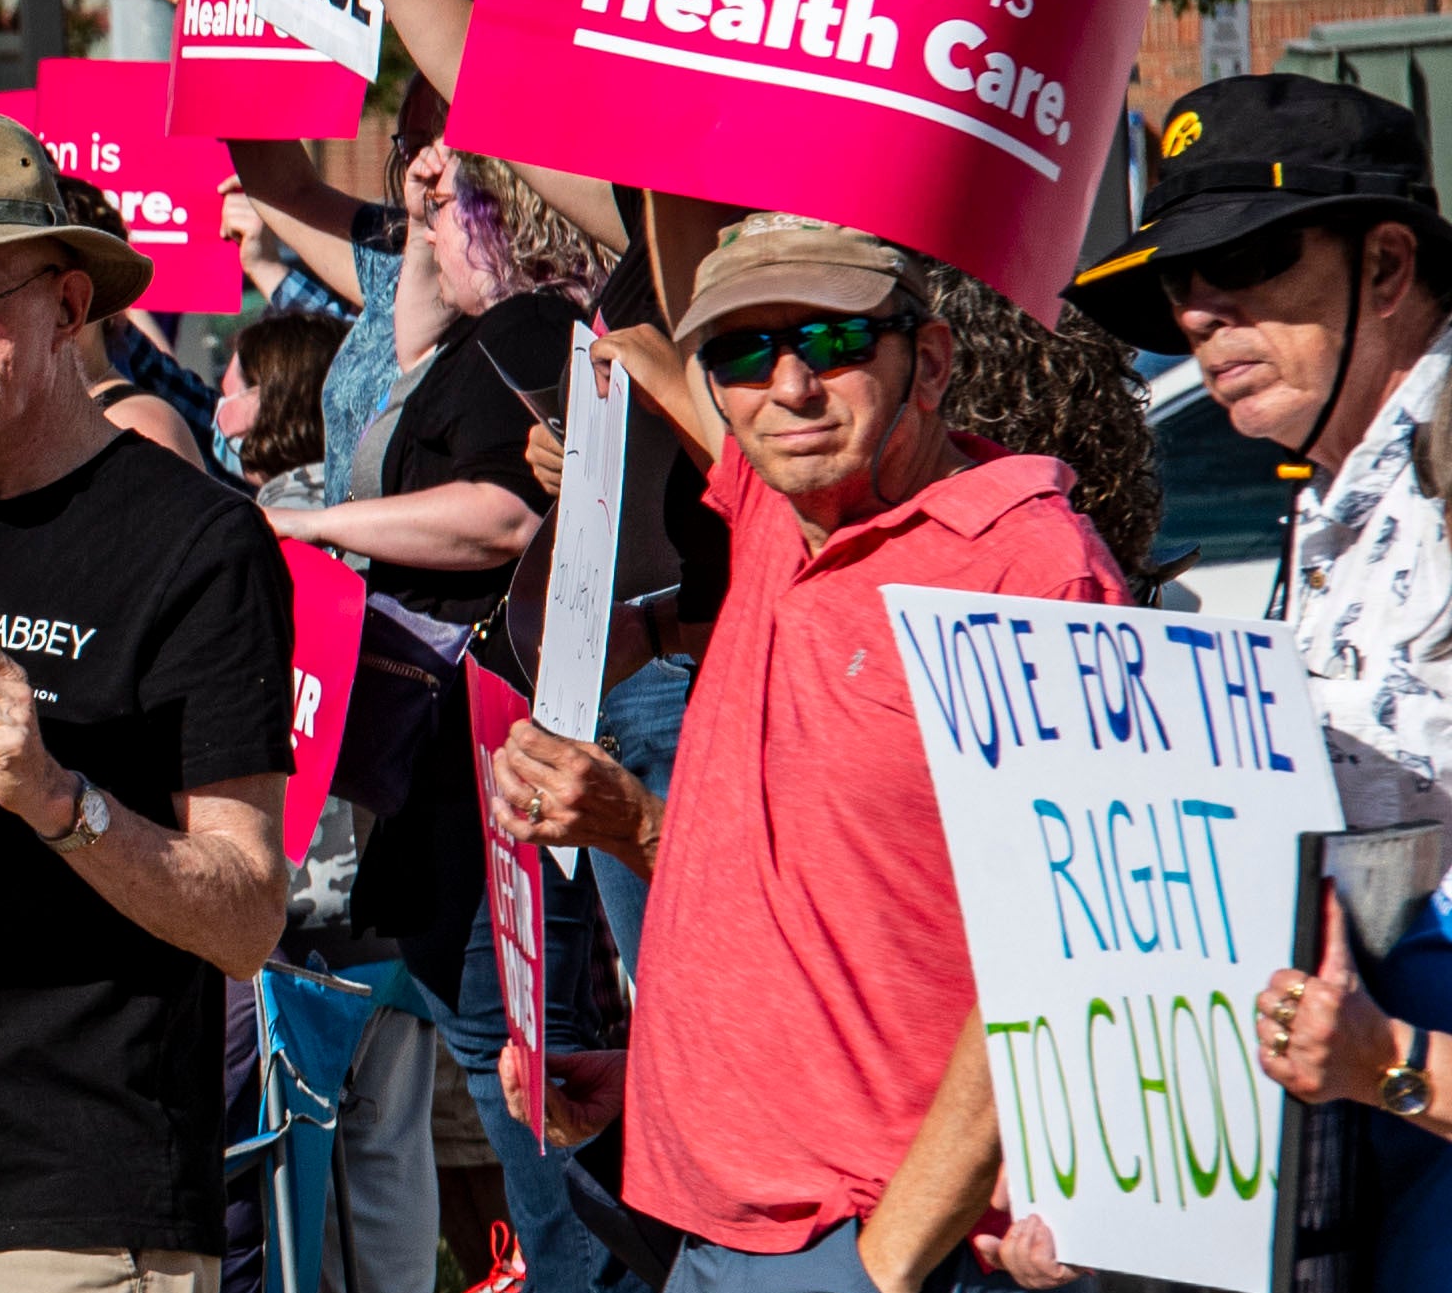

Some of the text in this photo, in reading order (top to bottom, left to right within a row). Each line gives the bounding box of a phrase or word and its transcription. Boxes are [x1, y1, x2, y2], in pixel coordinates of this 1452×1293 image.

[90, 132, 121, 173] is
[924, 19, 1072, 146] Care.
[900, 610, 1297, 773] VOTE FOR THE
[1033, 797, 1238, 964] RIGHT
[986, 990, 1278, 1210] TO CHOO
